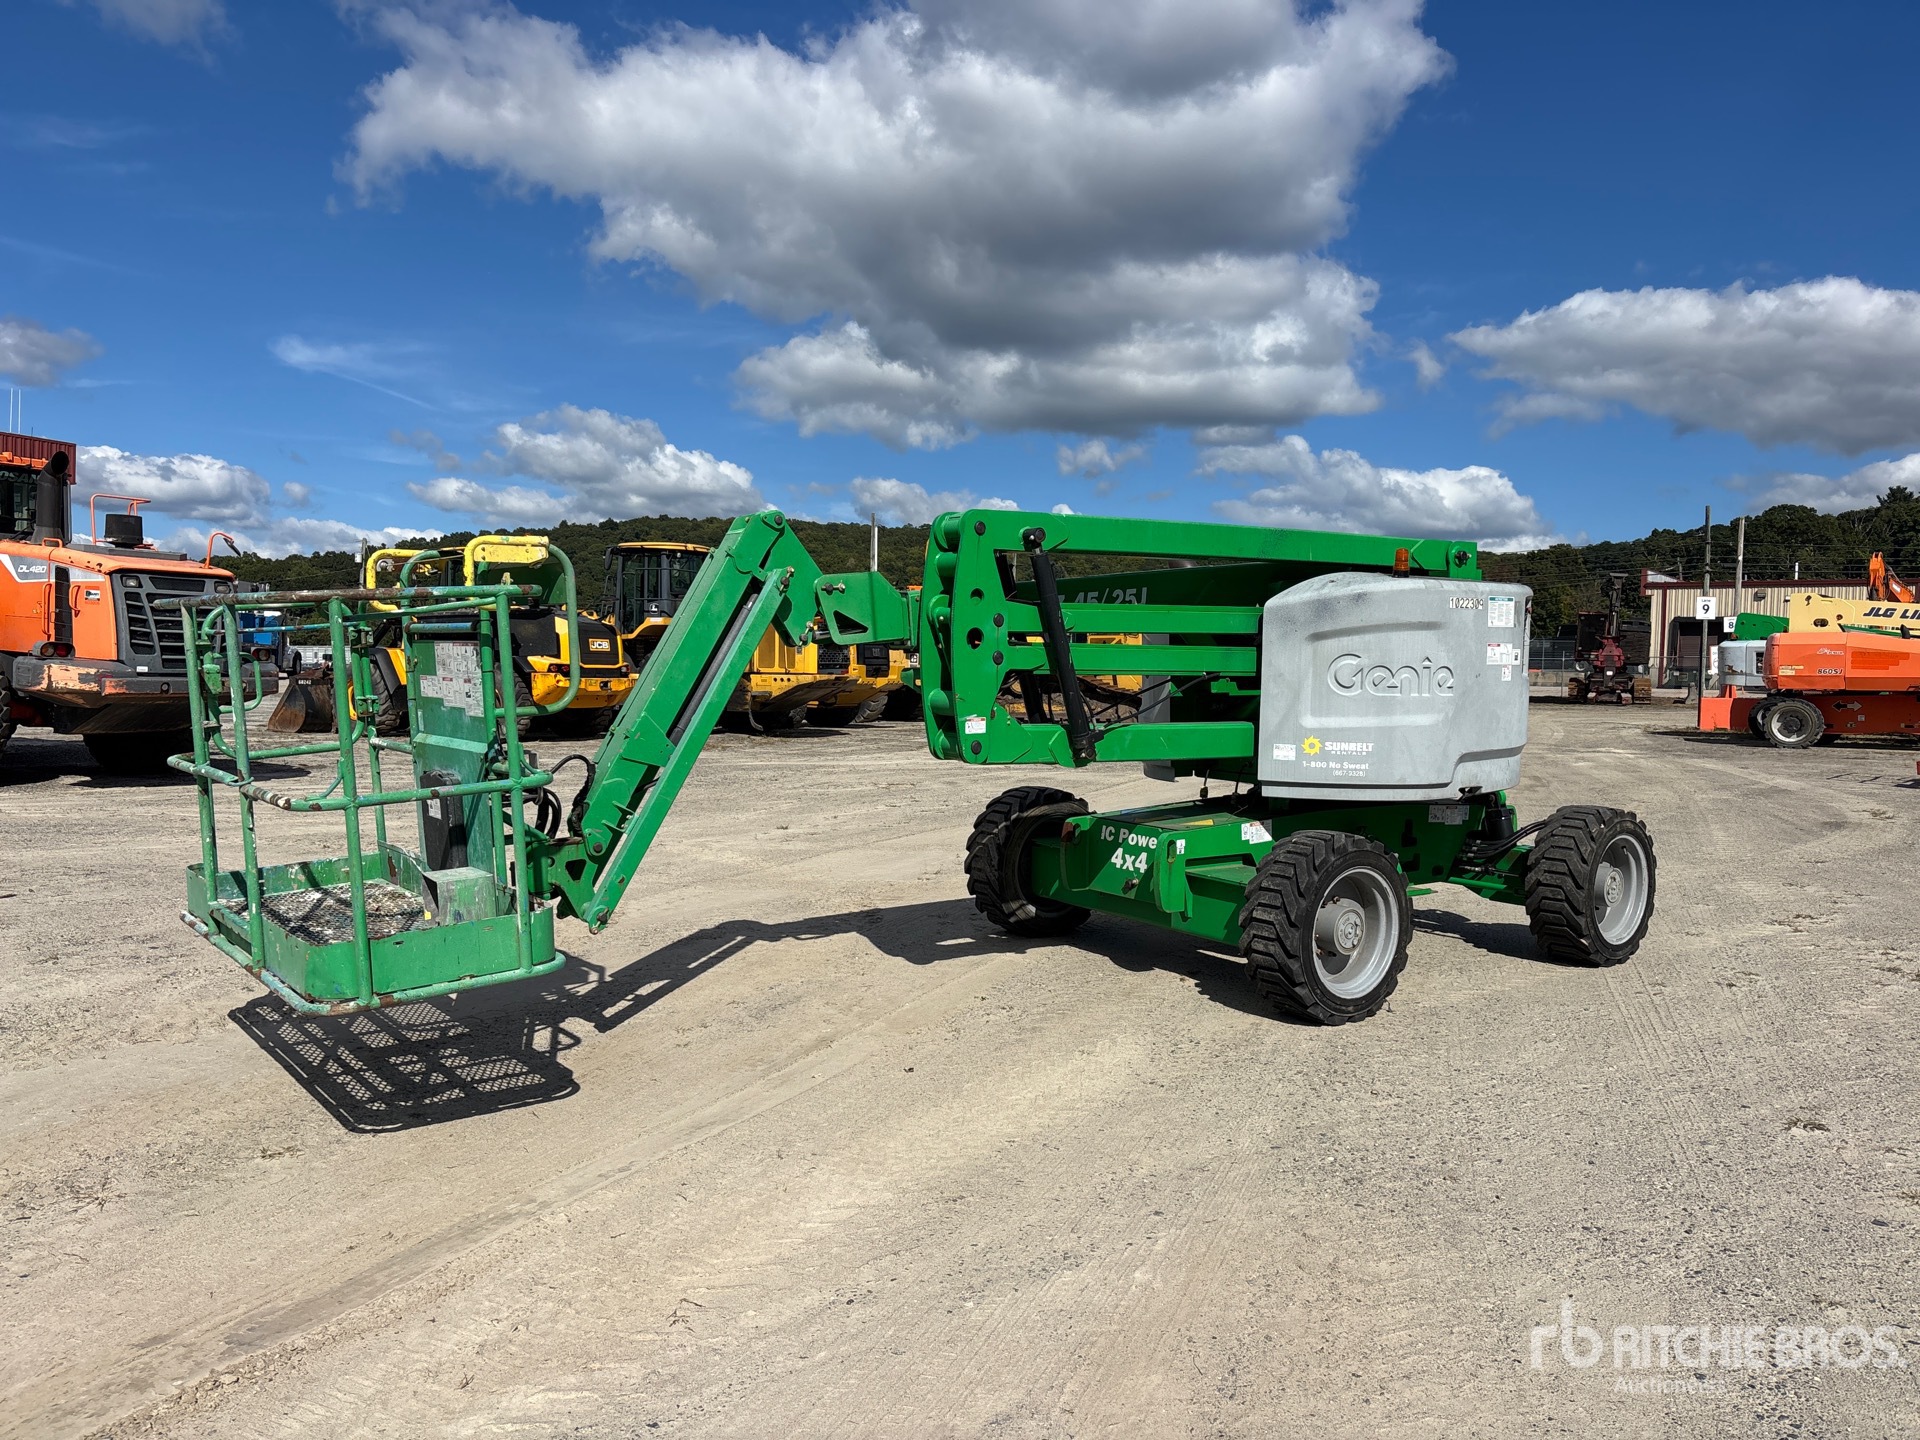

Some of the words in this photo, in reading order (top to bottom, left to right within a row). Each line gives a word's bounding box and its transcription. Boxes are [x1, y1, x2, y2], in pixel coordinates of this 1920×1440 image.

[17, 565, 47, 574] DL420
[1450, 597, 1484, 610] 1022309
[1702, 603, 1710, 615] 9
[1862, 606, 1898, 618] JLG
[1728, 621, 1734, 629] 8
[591, 641, 609, 649] JCB
[1327, 653, 1455, 697] Genie
[1324, 741, 1375, 752] SUNBELT
[1302, 760, 1328, 769] 1-800
[1328, 761, 1342, 769] No
[1342, 762, 1370, 770] Sweat
[1100, 824, 1116, 842] IC
[1118, 828, 1158, 850] Powe
[1110, 847, 1148, 874] 4x4
